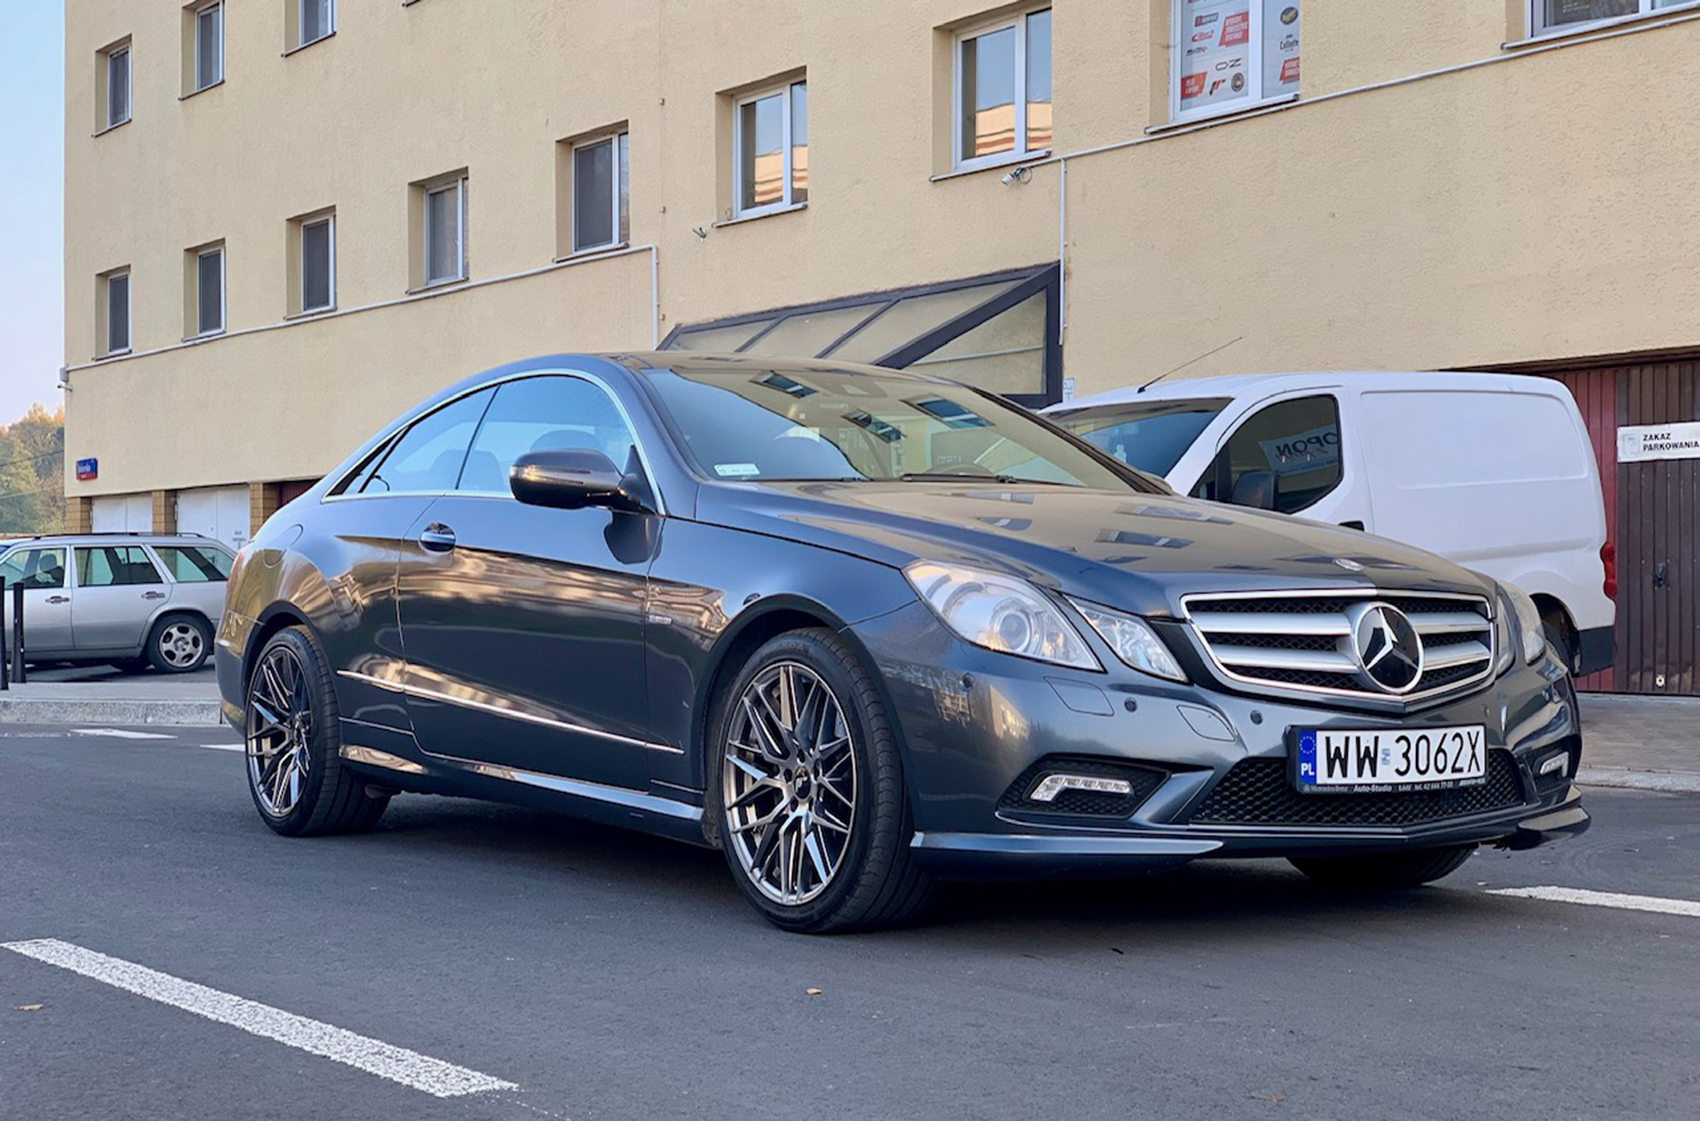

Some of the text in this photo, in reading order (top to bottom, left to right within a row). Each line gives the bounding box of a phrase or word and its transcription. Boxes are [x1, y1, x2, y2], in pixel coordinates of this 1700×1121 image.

[1215, 58, 1242, 71] OZ
[1643, 433, 1671, 441] ZAKAZ
[1643, 441, 1700, 452] PARKOWANIA
[1325, 731, 1481, 778] WW 3062X
[1301, 763, 1315, 776] PL
[1353, 784, 1392, 792] Auto-Studio
